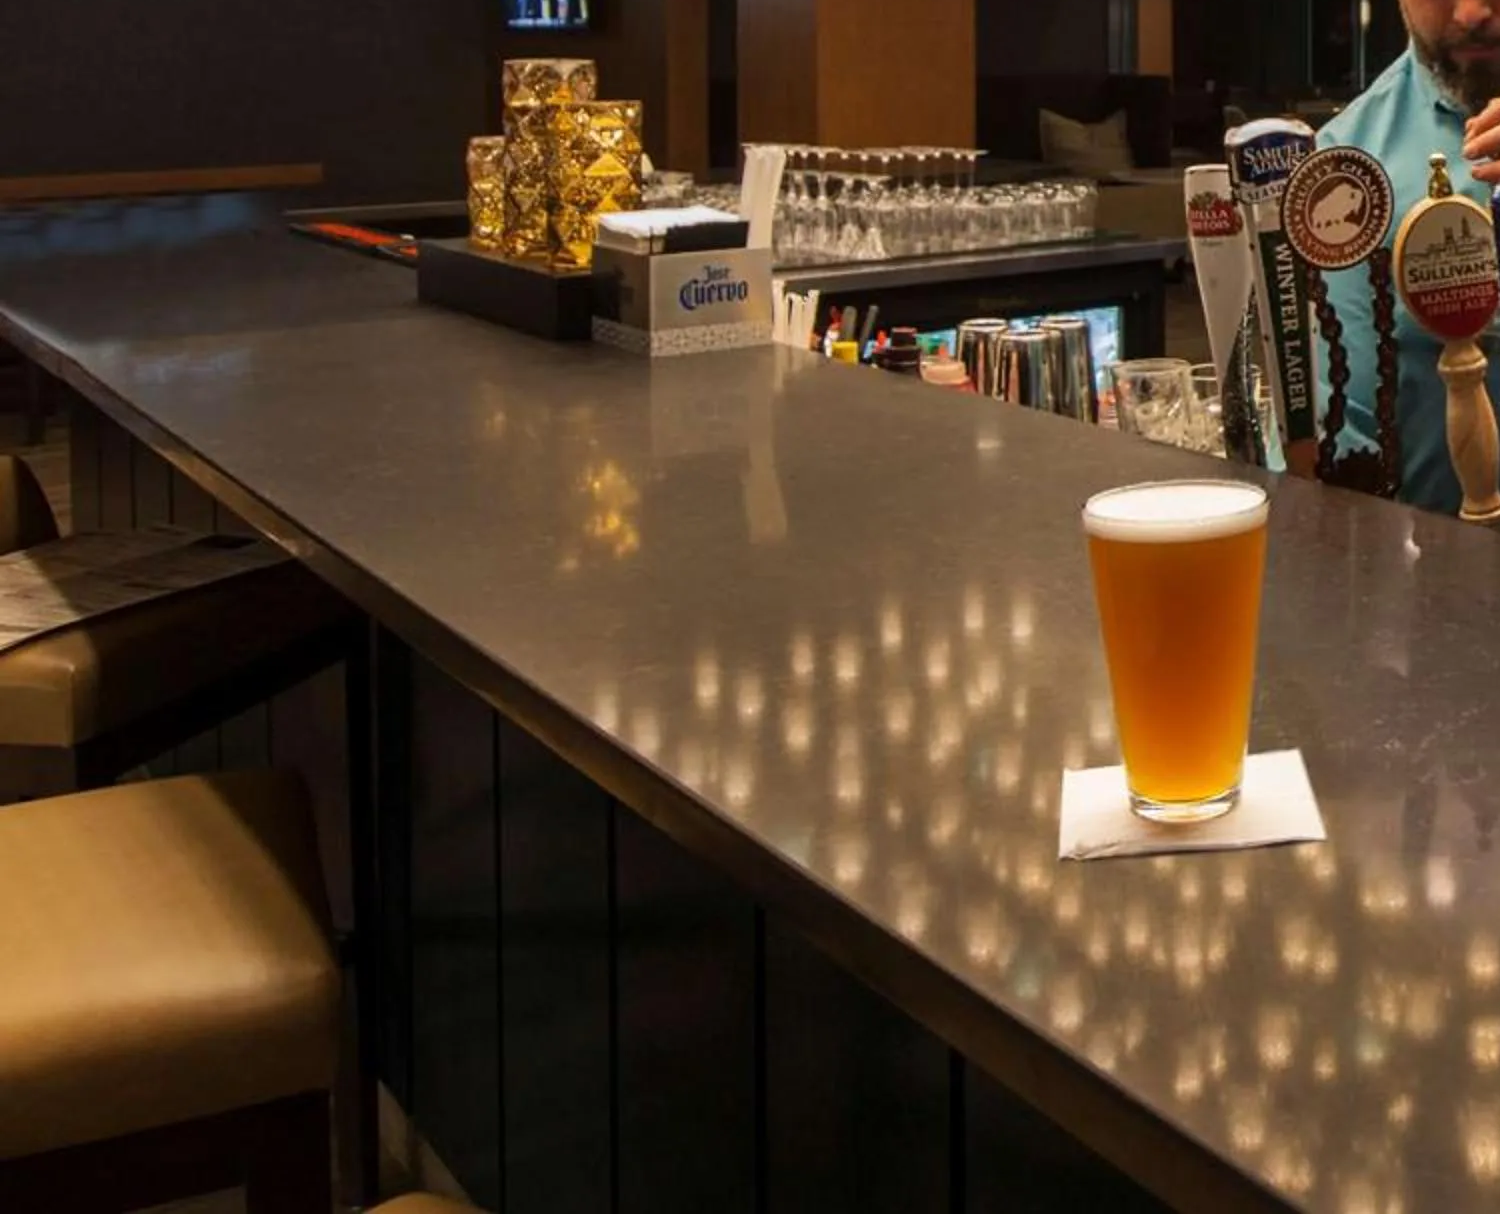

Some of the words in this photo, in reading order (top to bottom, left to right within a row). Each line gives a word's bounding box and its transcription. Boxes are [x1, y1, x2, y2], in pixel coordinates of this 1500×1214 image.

[1247, 184, 1285, 200] SEASO
[1408, 258, 1498, 284] SULLIVAN'S
[679, 279, 748, 311] Cuervo
[1274, 243, 1300, 332] WINTER
[1284, 340, 1308, 412] LAGER
